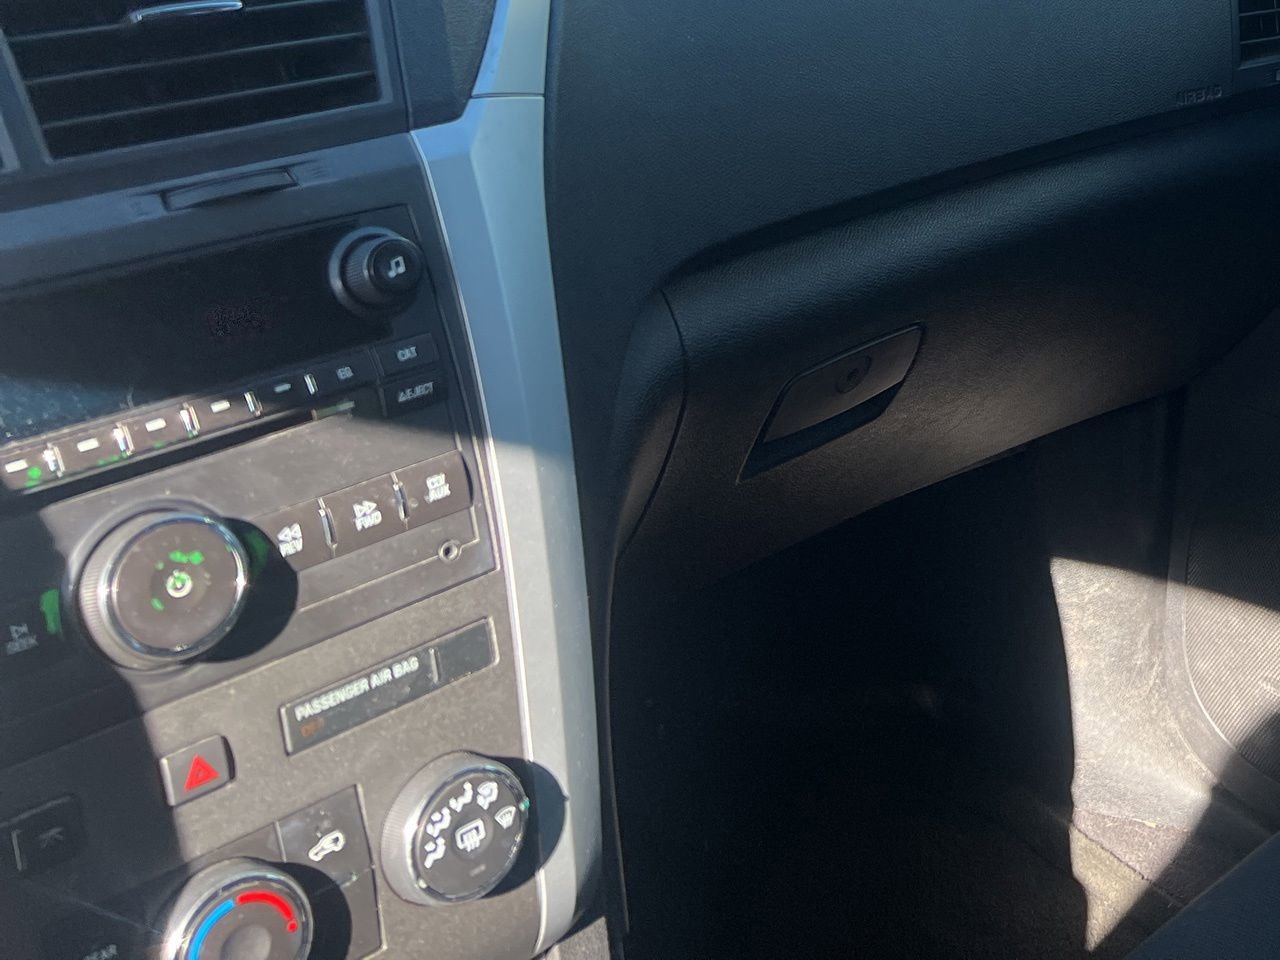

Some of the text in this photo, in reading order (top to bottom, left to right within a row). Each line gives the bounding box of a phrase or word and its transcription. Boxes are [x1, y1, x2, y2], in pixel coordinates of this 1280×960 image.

[428, 483, 452, 503] AUX
[354, 510, 383, 532] FWD
[294, 655, 420, 722] PASSENGER AIR BAG
